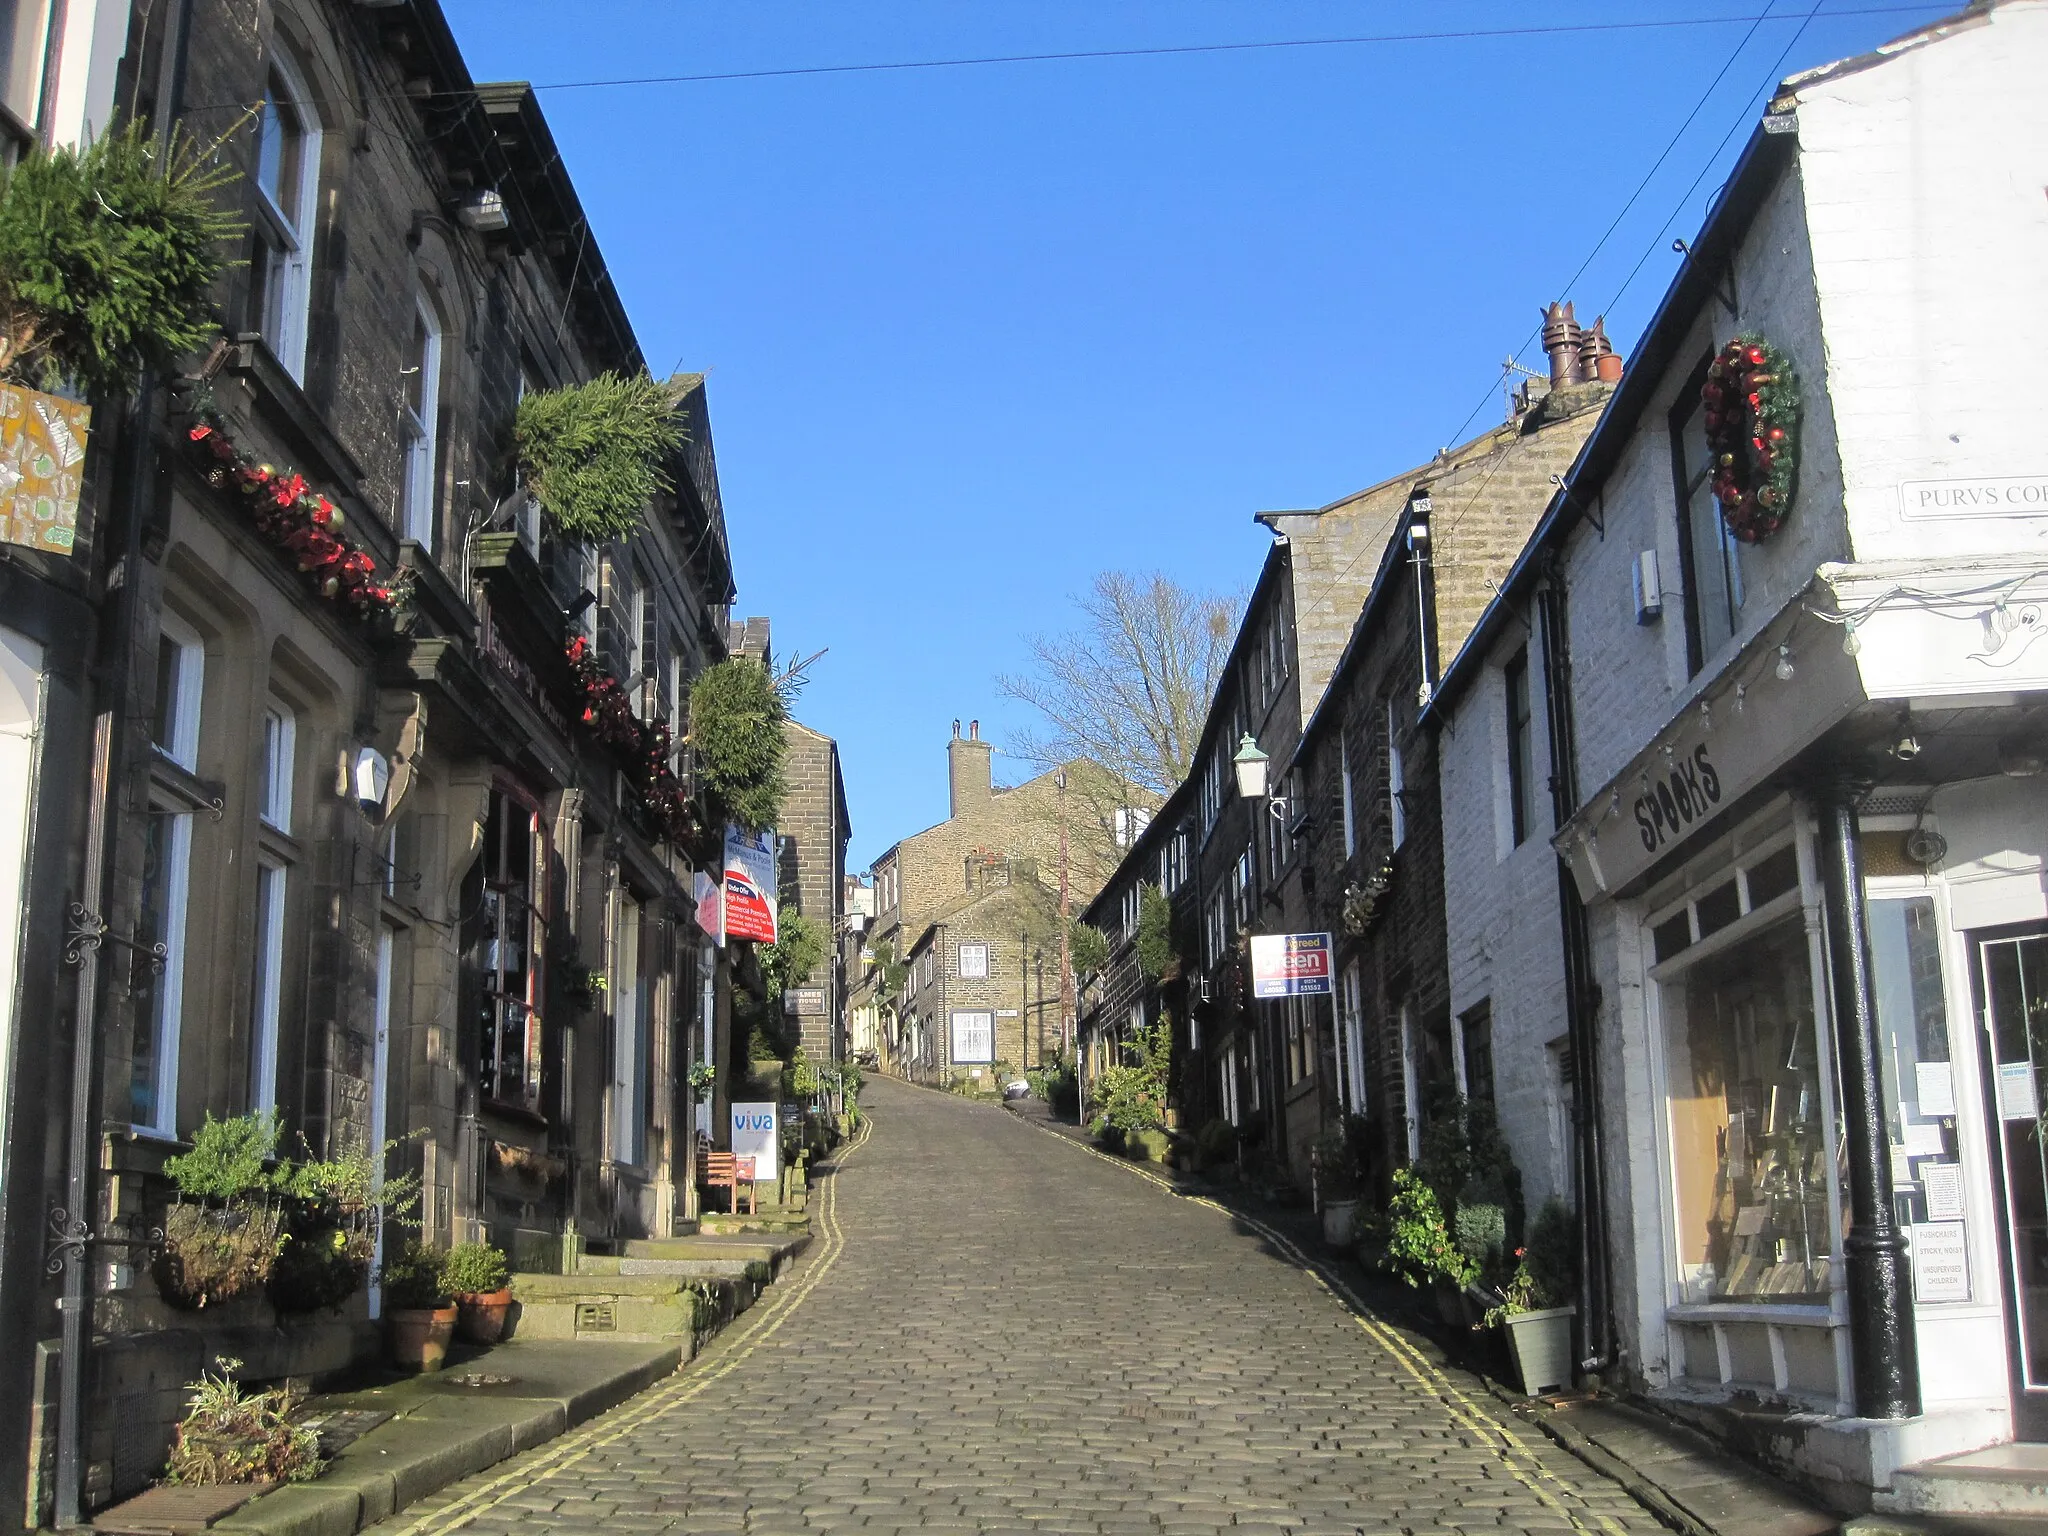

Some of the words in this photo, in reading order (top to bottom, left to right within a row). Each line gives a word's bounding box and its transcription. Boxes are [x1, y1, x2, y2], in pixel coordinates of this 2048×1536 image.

[1919, 487, 1999, 508] PURVS
[1633, 742, 1721, 853] SPOOKS
[734, 1109, 773, 1131] viva
[1928, 1277, 1958, 1285] CHILDREN
